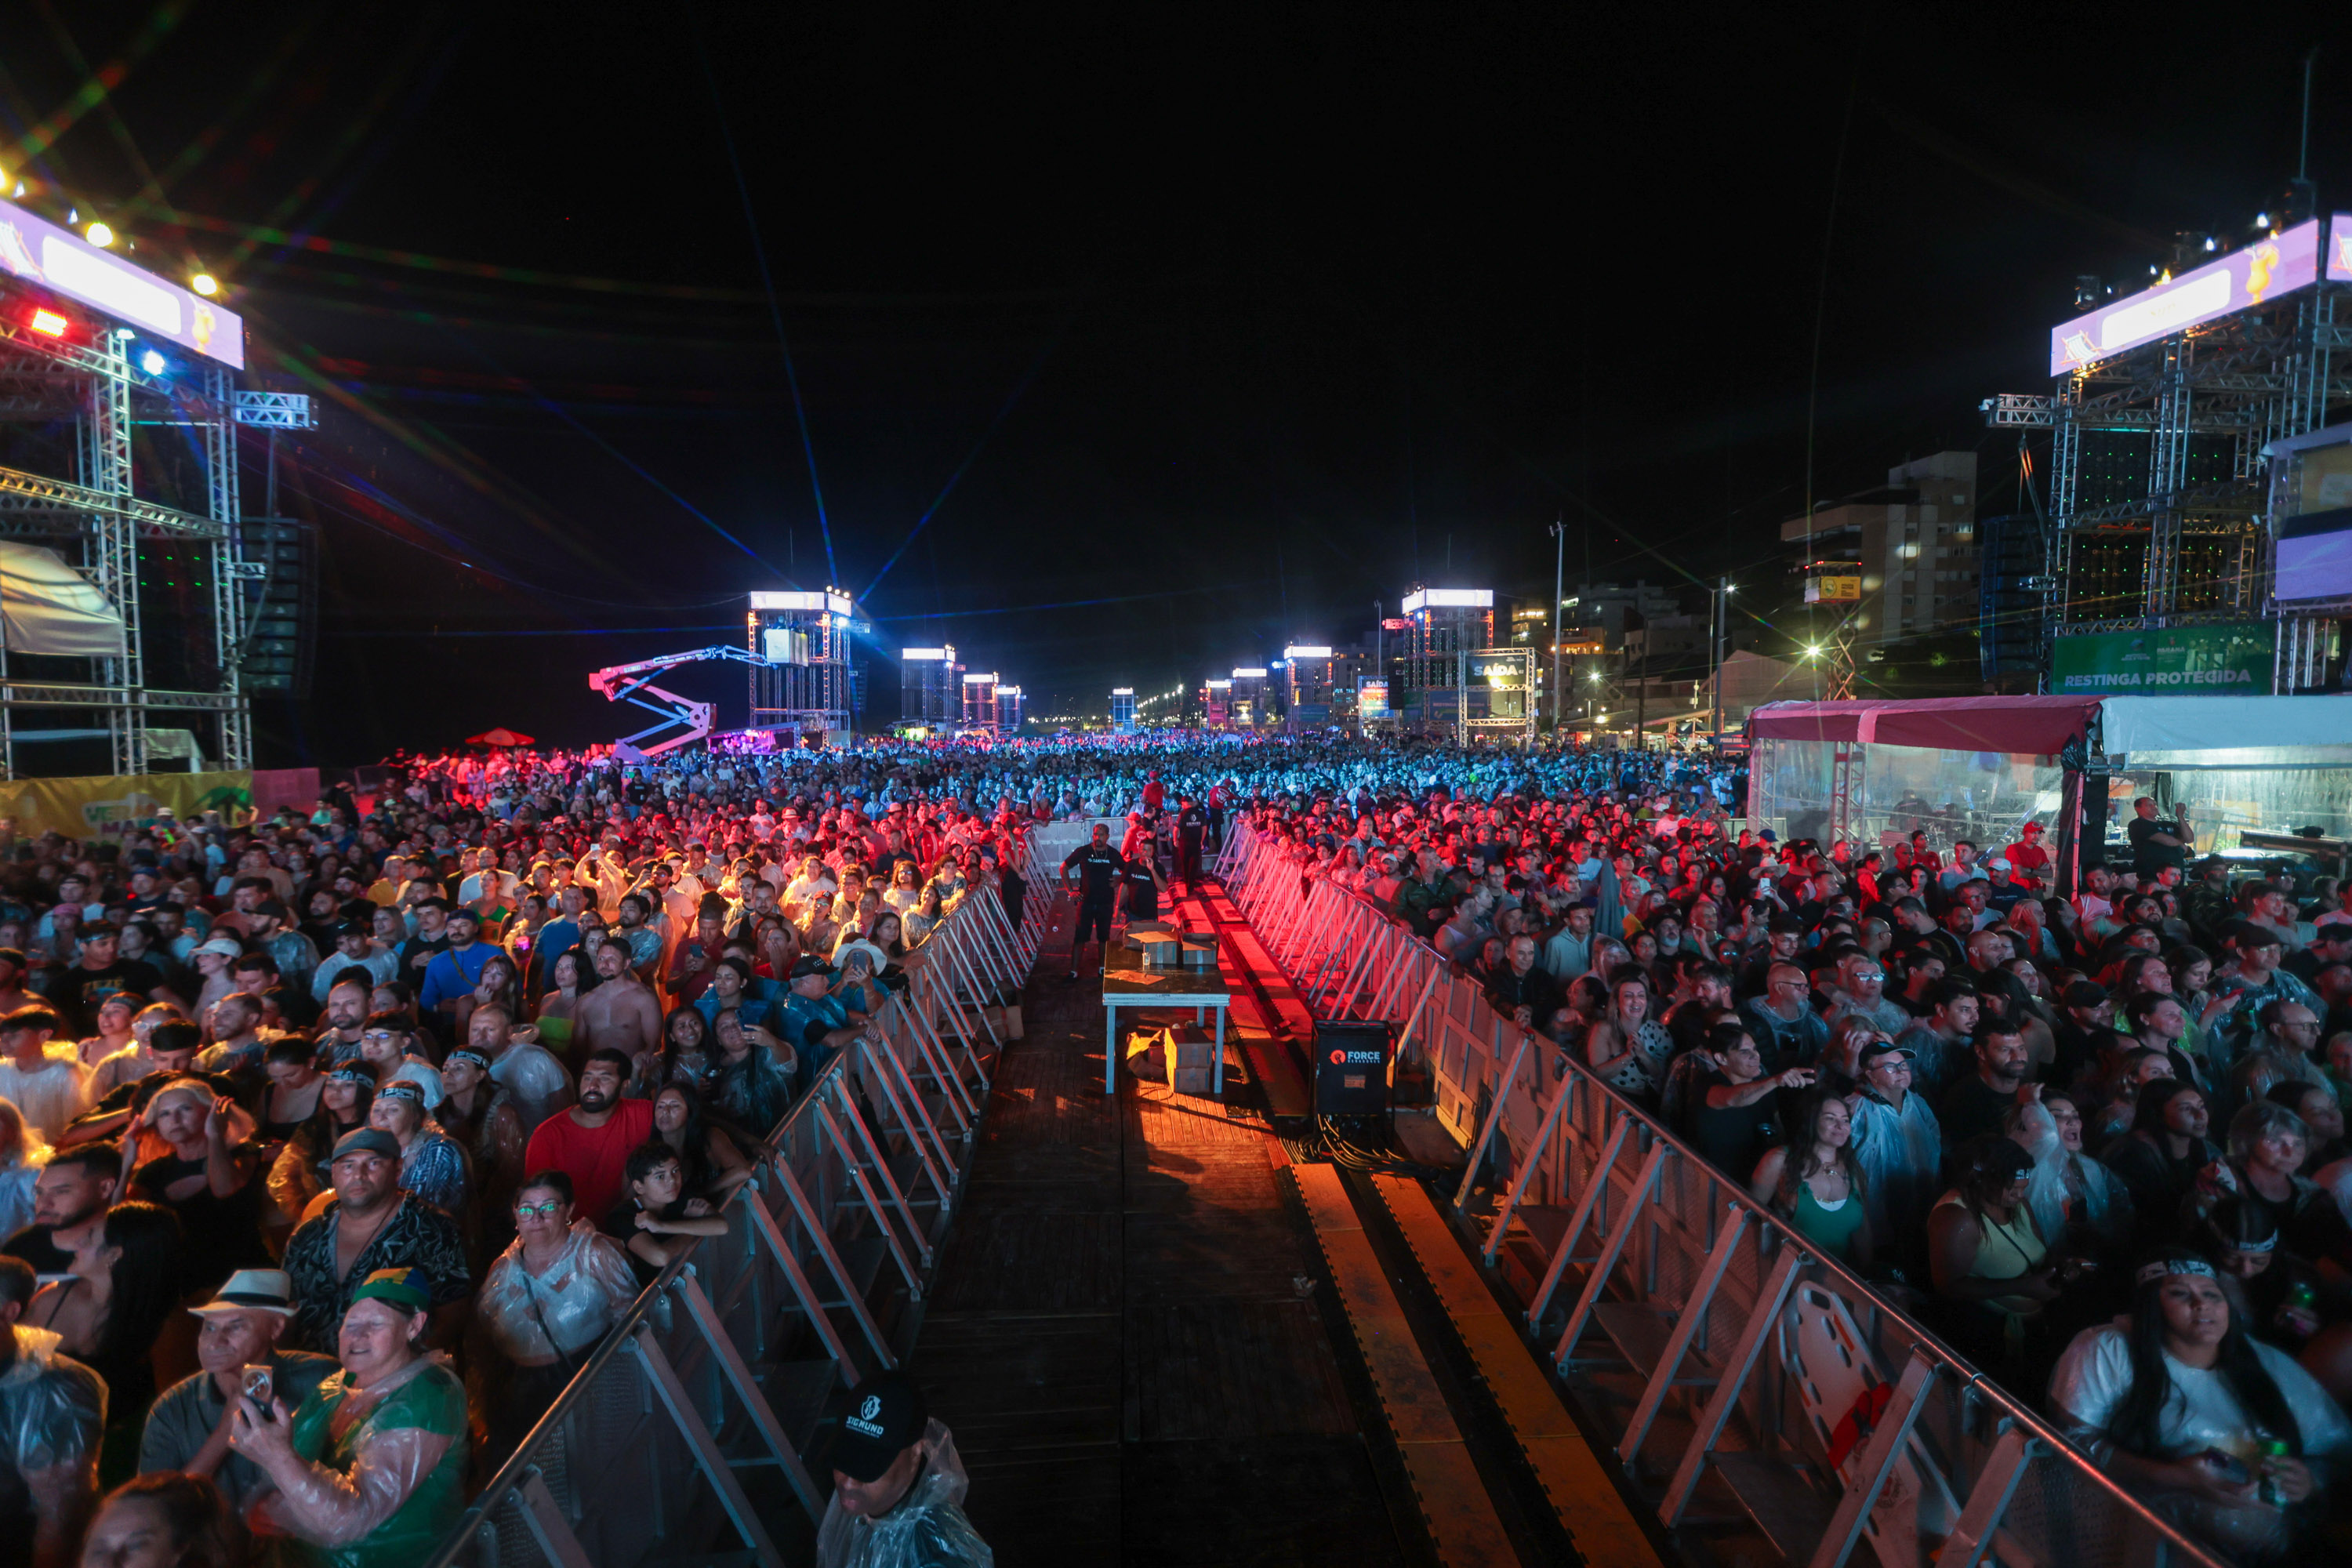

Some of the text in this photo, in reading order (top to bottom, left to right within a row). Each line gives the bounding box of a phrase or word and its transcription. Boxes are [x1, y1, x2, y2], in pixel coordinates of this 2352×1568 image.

[1474, 662, 1518, 676] SAÍDA
[2064, 669, 2252, 687] RESTINGA PROTEGIDA
[1348, 1051, 1380, 1060] FORCE
[846, 1416, 884, 1435] SIGMUND
